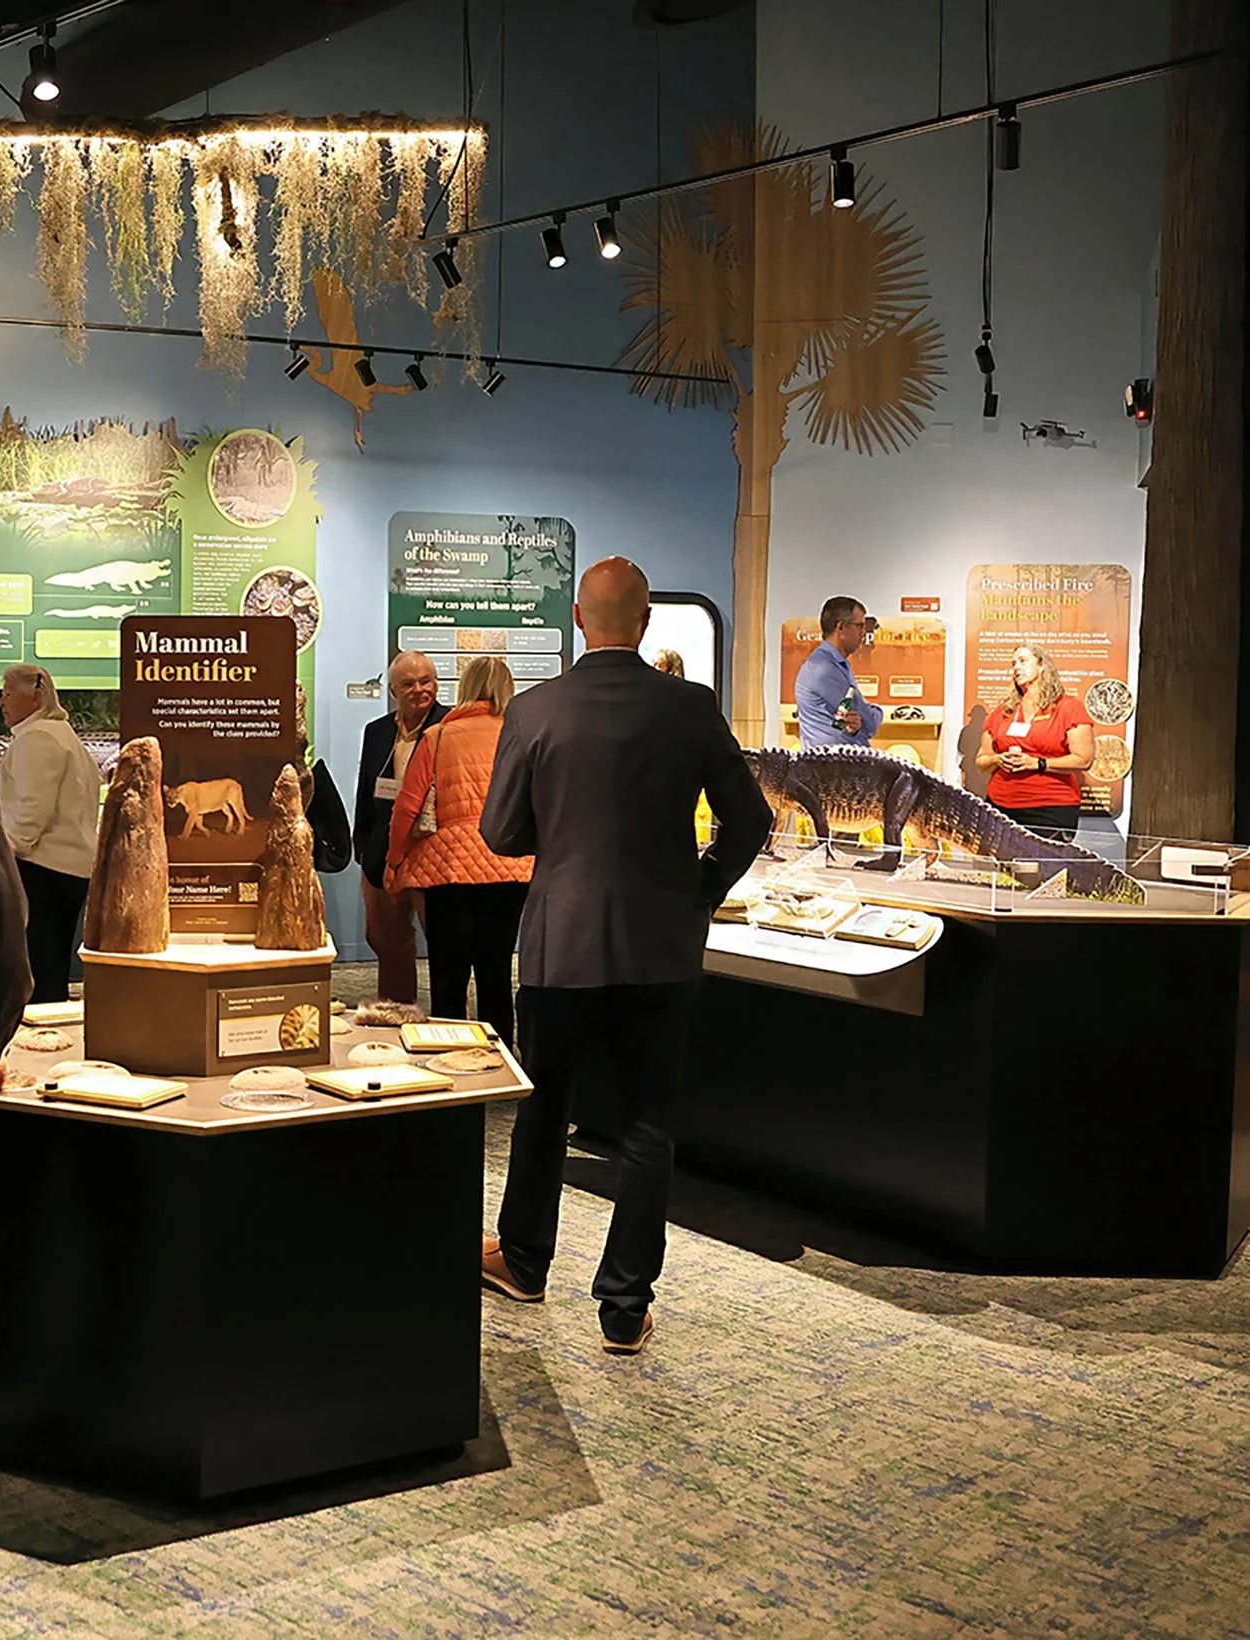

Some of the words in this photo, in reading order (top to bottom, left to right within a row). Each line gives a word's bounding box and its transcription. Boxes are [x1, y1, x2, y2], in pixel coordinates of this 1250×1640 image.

[404, 529, 481, 547] Amphibians
[482, 532, 506, 545] and
[507, 533, 557, 550] Reptiles
[404, 547, 418, 560] of
[420, 548, 441, 561] the
[443, 548, 489, 566] Swamp
[982, 578, 1060, 591] Prescribed
[1063, 578, 1094, 592] Fire
[426, 600, 444, 609] How
[444, 602, 459, 610] can
[460, 602, 475, 611] you
[476, 601, 488, 610] tell
[490, 602, 510, 610] them
[511, 602, 536, 612] apart?
[981, 594, 1054, 606] Maintains
[1056, 594, 1081, 605] the
[419, 615, 455, 625] Amphibian
[521, 617, 545, 626] Reptile
[981, 608, 1058, 623] Landscape
[877, 627, 897, 642] for
[135, 630, 248, 654] Mammal
[135, 657, 258, 682] Identifier
[157, 698, 190, 706] Mammals
[192, 698, 208, 706] have
[215, 698, 225, 706] lot
[226, 698, 233, 706] in
[268, 698, 280, 706] but
[152, 707, 176, 715] special
[178, 707, 227, 715] characteristics
[259, 708, 280, 716] apart.
[158, 720, 173, 728] Can
[174, 721, 187, 729] you
[188, 720, 214, 729] identify
[215, 720, 235, 728] these
[236, 720, 270, 728] mammals
[271, 720, 280, 729] by
[213, 729, 225, 737] the
[226, 729, 244, 737] clues
[245, 729, 280, 738] provided?
[201, 875, 210, 883] of
[185, 885, 208, 893] Name
[210, 885, 232, 893] Here!
